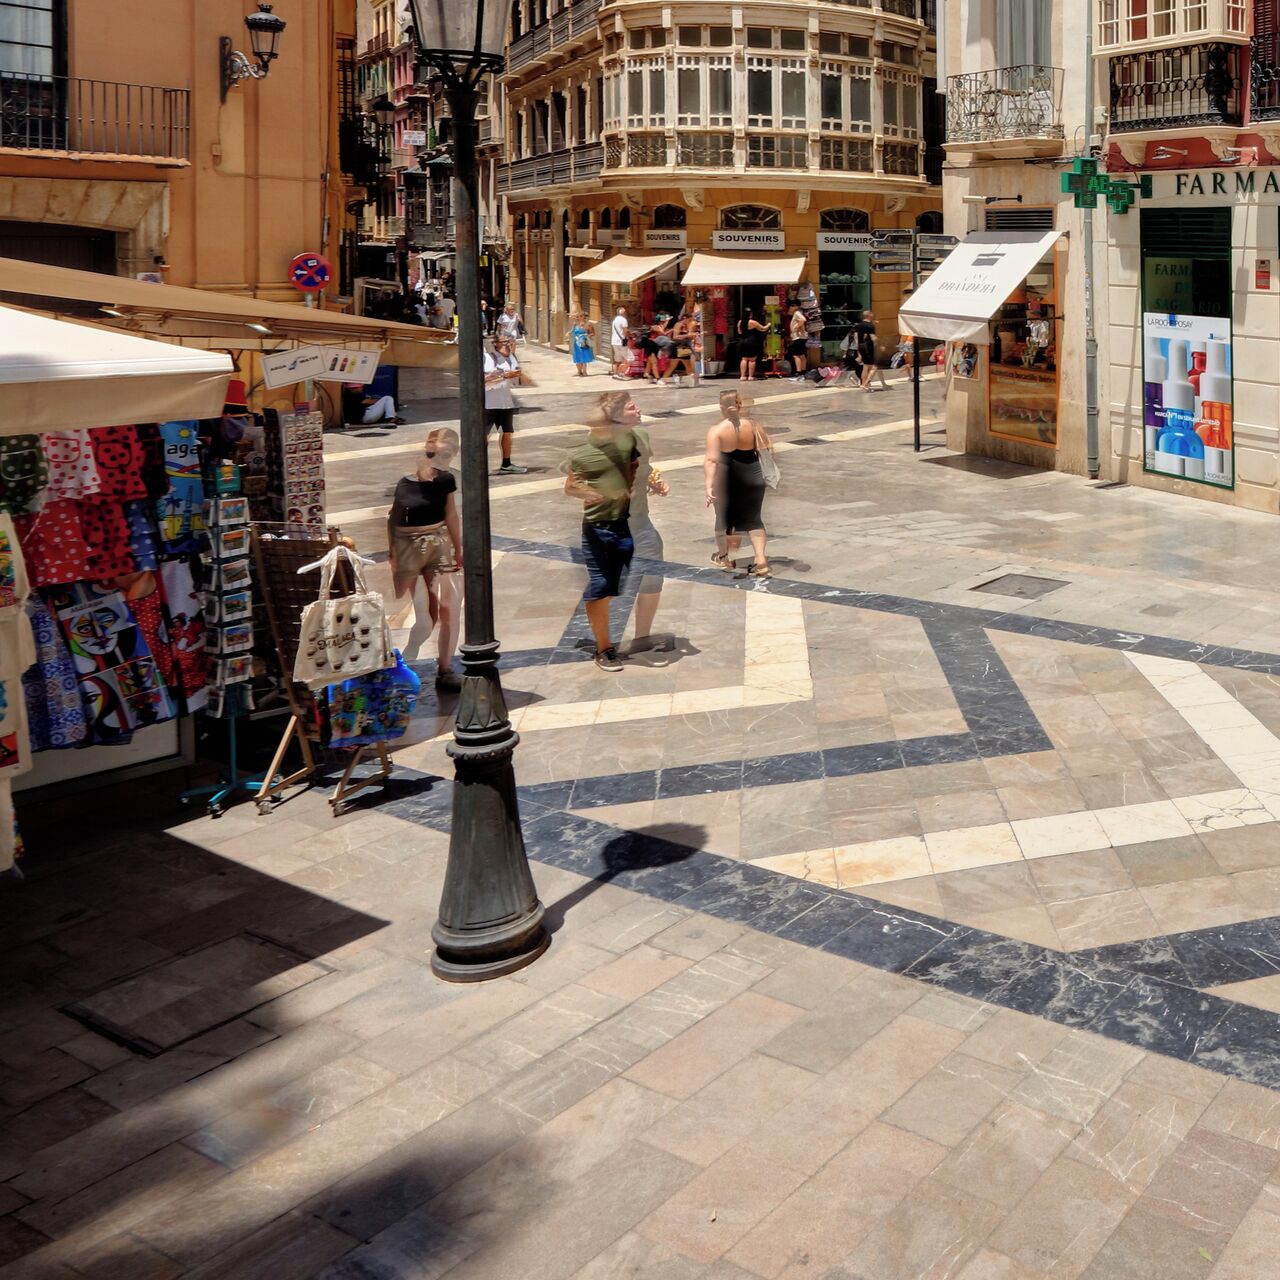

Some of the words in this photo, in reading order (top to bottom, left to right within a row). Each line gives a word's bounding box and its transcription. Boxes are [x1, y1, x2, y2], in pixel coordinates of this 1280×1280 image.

[646, 233, 680, 241] SOUVENIRS
[718, 234, 779, 243] SOUVENIRS
[824, 236, 873, 244] SOUVENIRS
